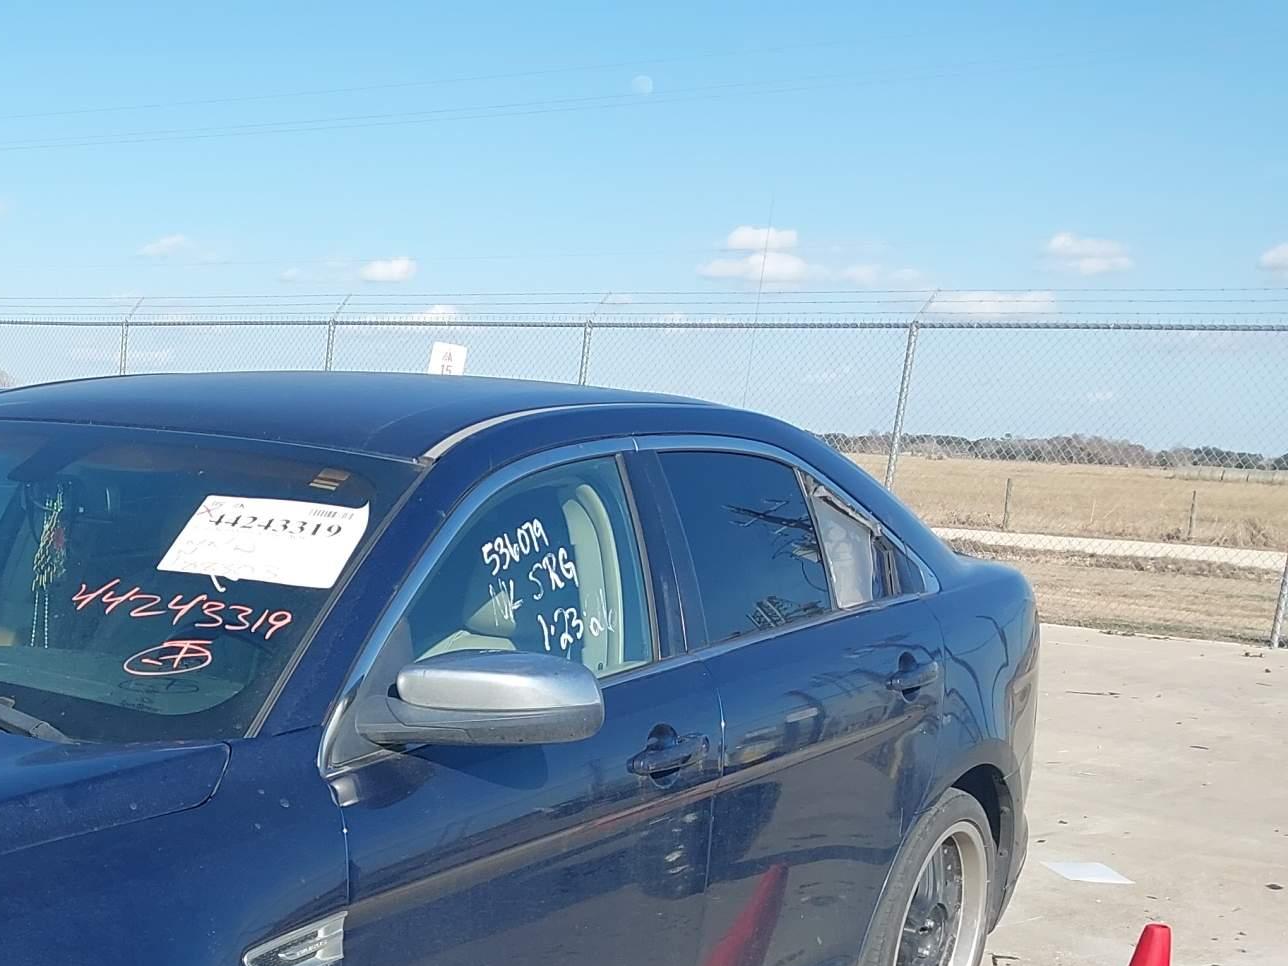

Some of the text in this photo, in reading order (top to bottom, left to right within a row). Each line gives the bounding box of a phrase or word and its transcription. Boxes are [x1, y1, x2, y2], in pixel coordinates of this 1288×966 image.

[208, 514, 342, 537] 44243319
[481, 518, 549, 576] 536079
[72, 578, 293, 640] 44243319
